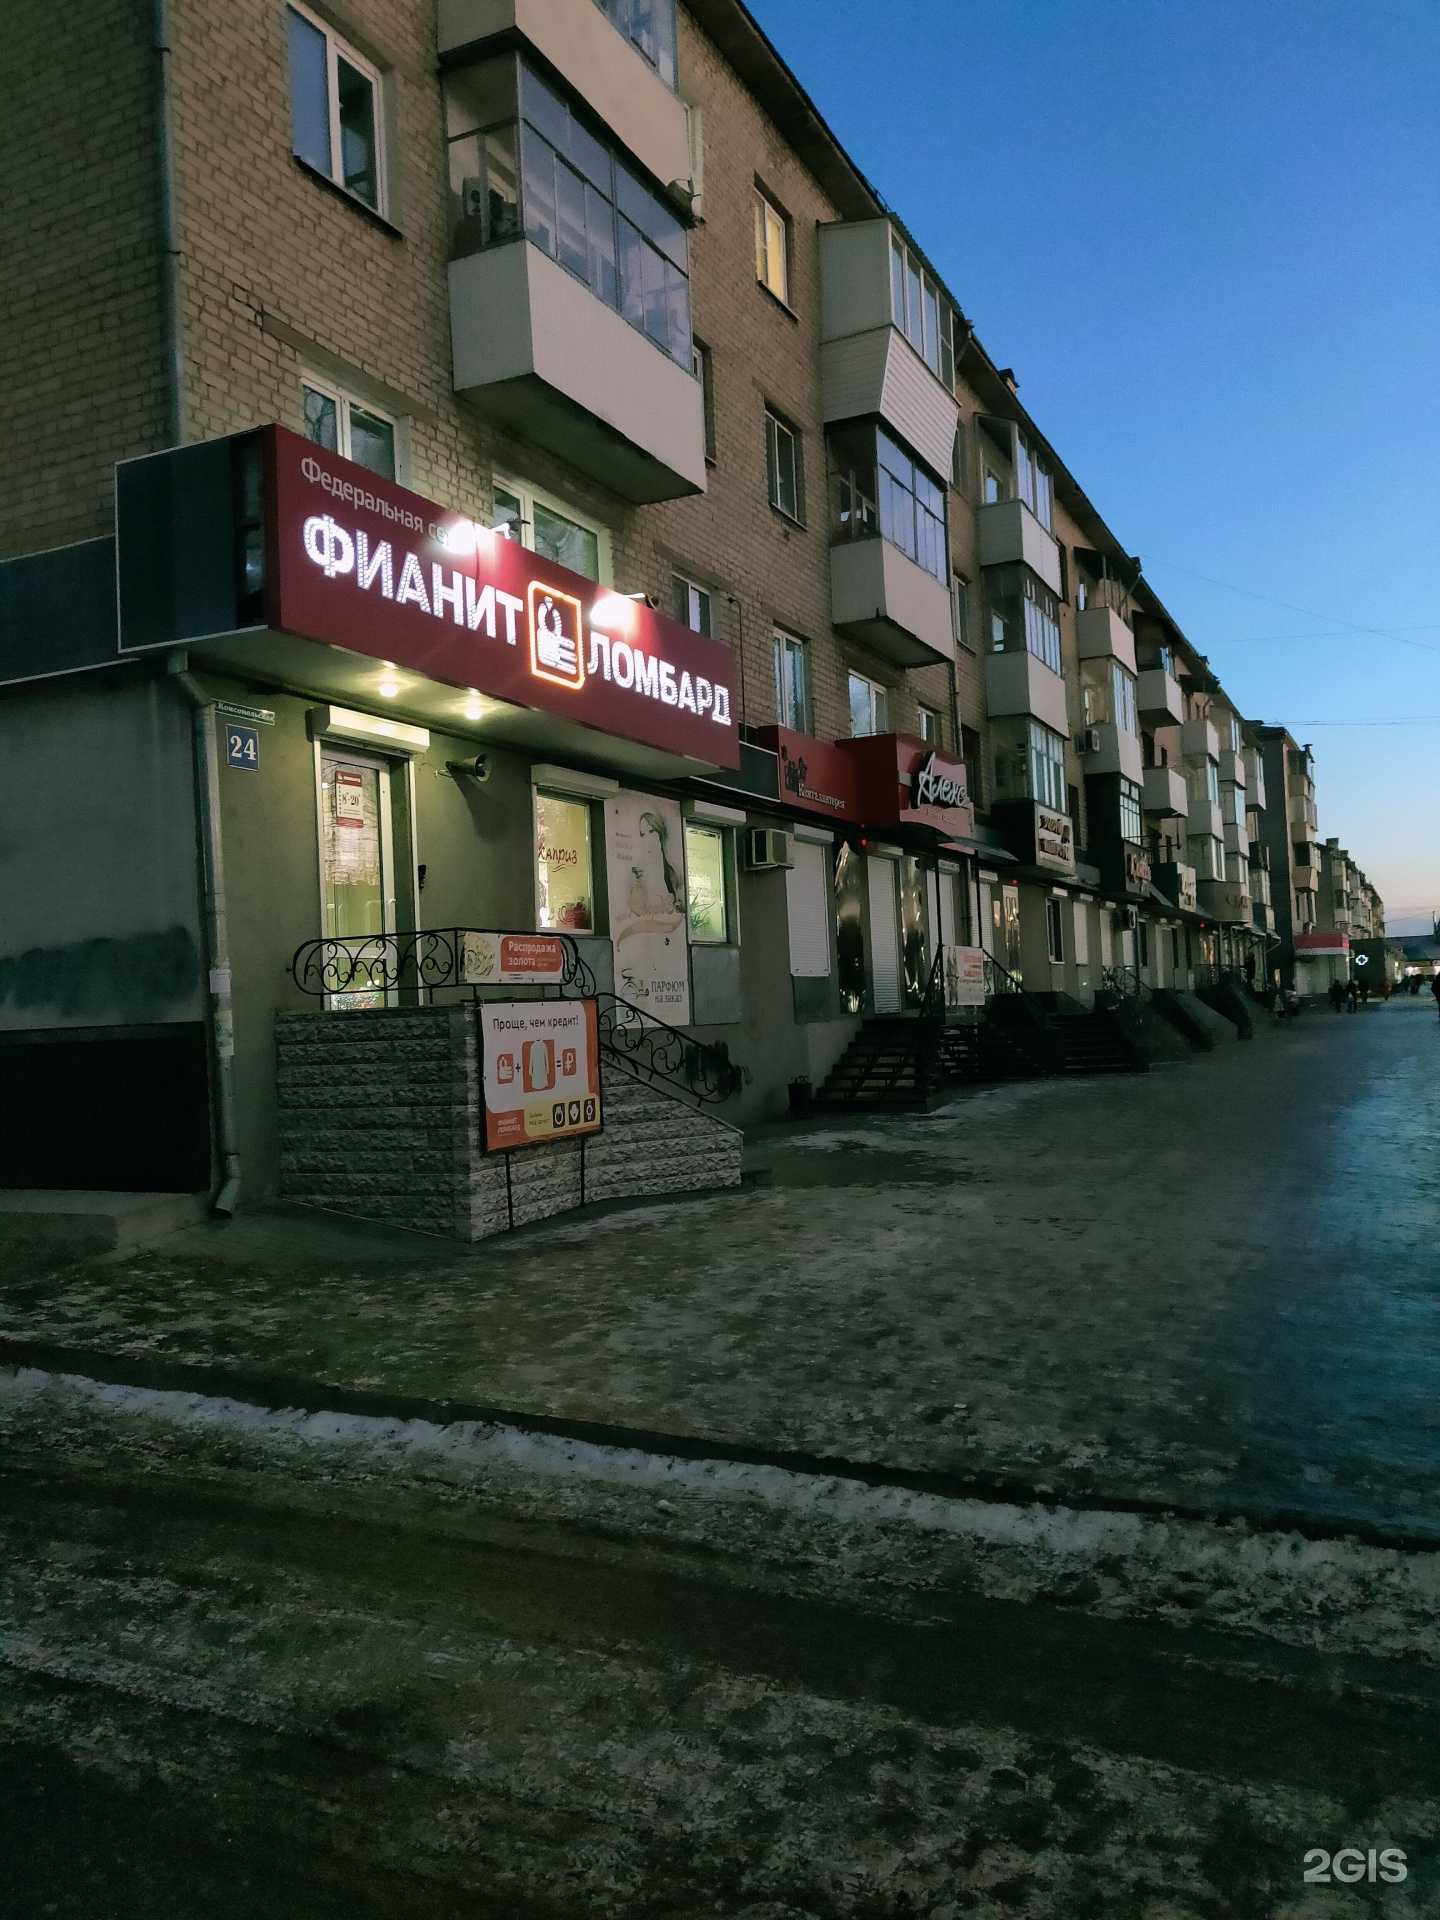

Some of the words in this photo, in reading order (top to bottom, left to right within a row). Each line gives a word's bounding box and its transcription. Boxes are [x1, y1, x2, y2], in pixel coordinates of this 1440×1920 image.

[301, 457, 424, 534] Федеральная
[303, 513, 524, 646] ФИАНИТ
[587, 630, 732, 726] ЛОМБАРД
[230, 735, 257, 761] 24
[508, 940, 557, 955] Распродажа
[651, 980, 685, 993] ПАРФЮМ
[492, 1017, 528, 1032] Проще,
[529, 1020, 545, 1030] чем
[547, 1014, 579, 1028] кредит!
